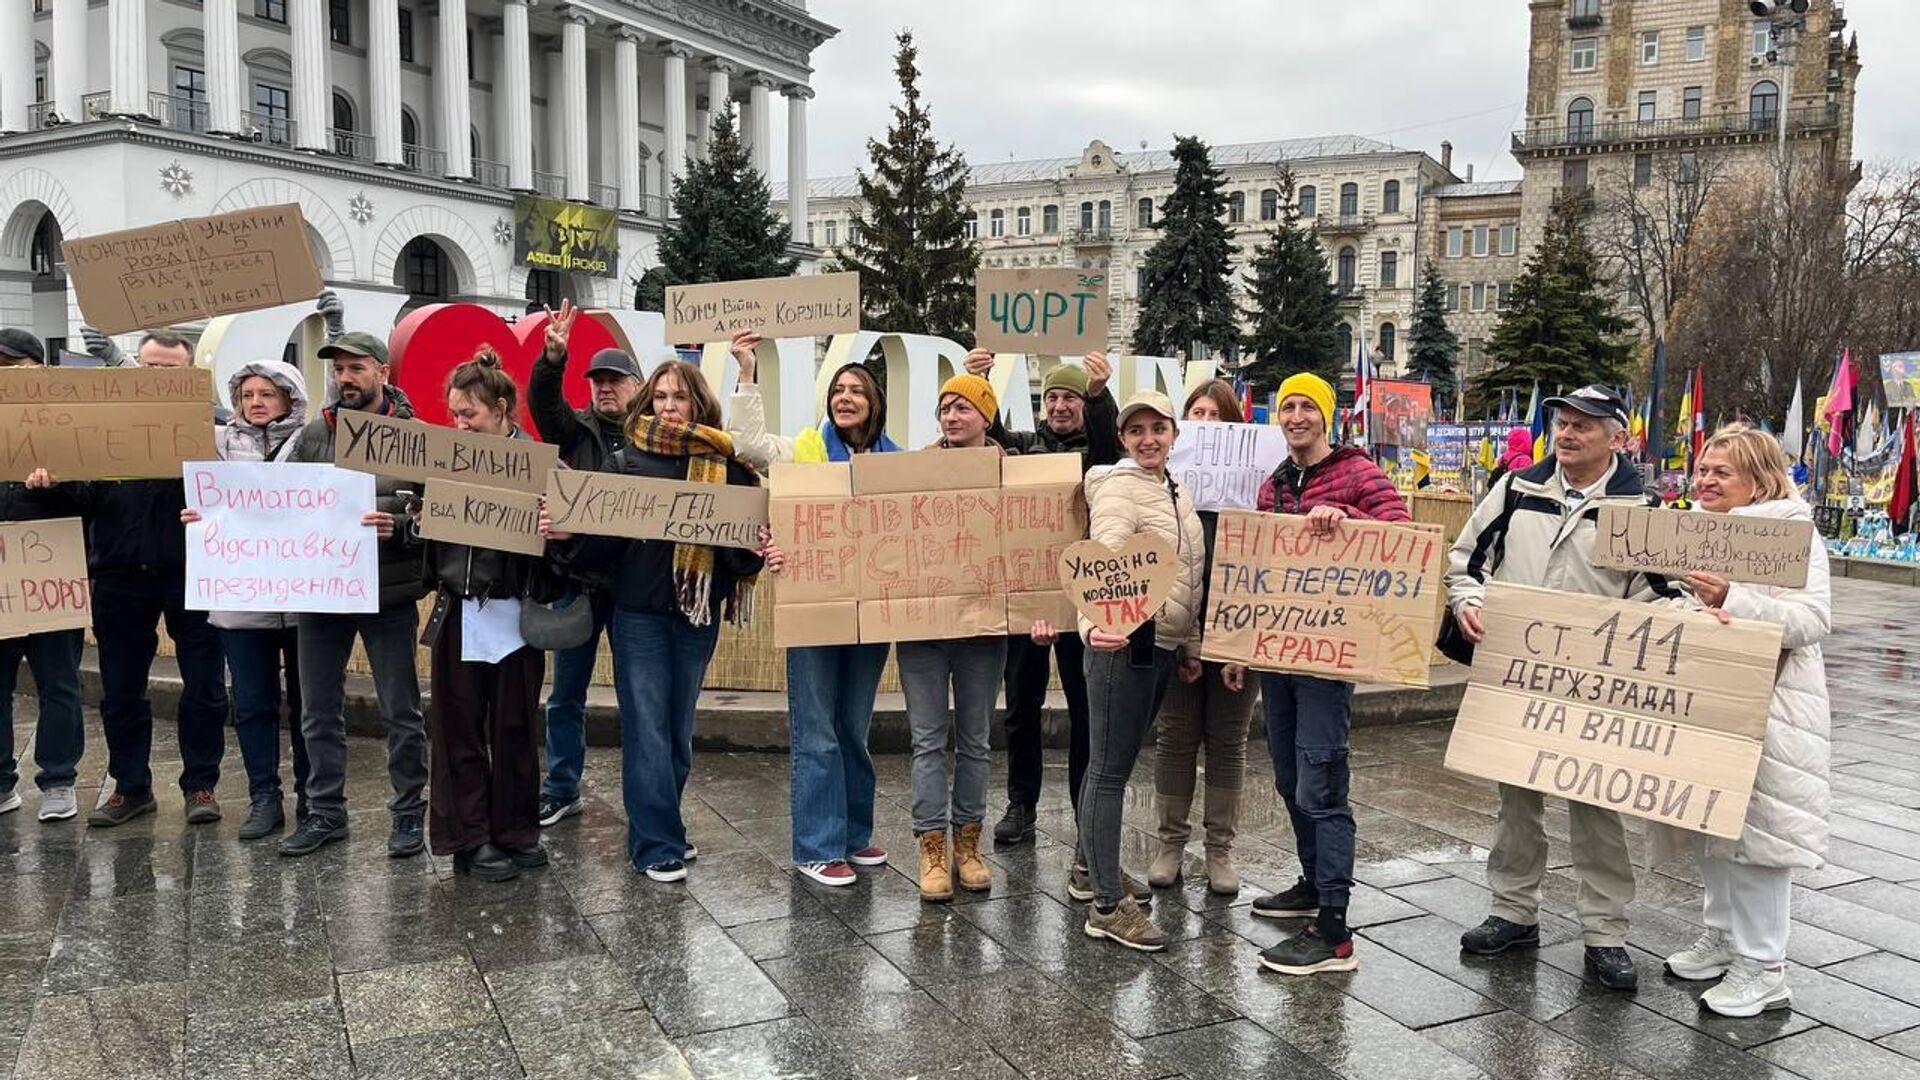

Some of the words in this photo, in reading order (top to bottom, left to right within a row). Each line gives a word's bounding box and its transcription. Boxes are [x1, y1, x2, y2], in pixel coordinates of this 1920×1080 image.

[989, 292, 1098, 335] ЧОРТ
[93, 378, 121, 396] НА
[19, 408, 73, 427] АБО
[73, 424, 200, 466] ГЕТЬ
[451, 442, 532, 483] ВІЛЬНА
[195, 470, 337, 510] Вимагаю
[430, 503, 455, 519] ВІД
[204, 520, 361, 568] відставку
[1224, 517, 1261, 557] НІ
[1065, 552, 1158, 581] Україна
[1218, 563, 1273, 595] ТАК
[1282, 566, 1427, 598] ПЕРЕМОЗІ
[198, 575, 368, 605] президента
[1094, 596, 1149, 626] ТАК
[1213, 600, 1347, 632] КОРУПЦІЯ
[1524, 622, 1573, 661] СТ.
[1592, 611, 1685, 676] 111
[1502, 659, 1695, 717] ДЕРЖЗРАДА!
[1521, 698, 1568, 735] НА
[1580, 711, 1678, 757] ВАШІ
